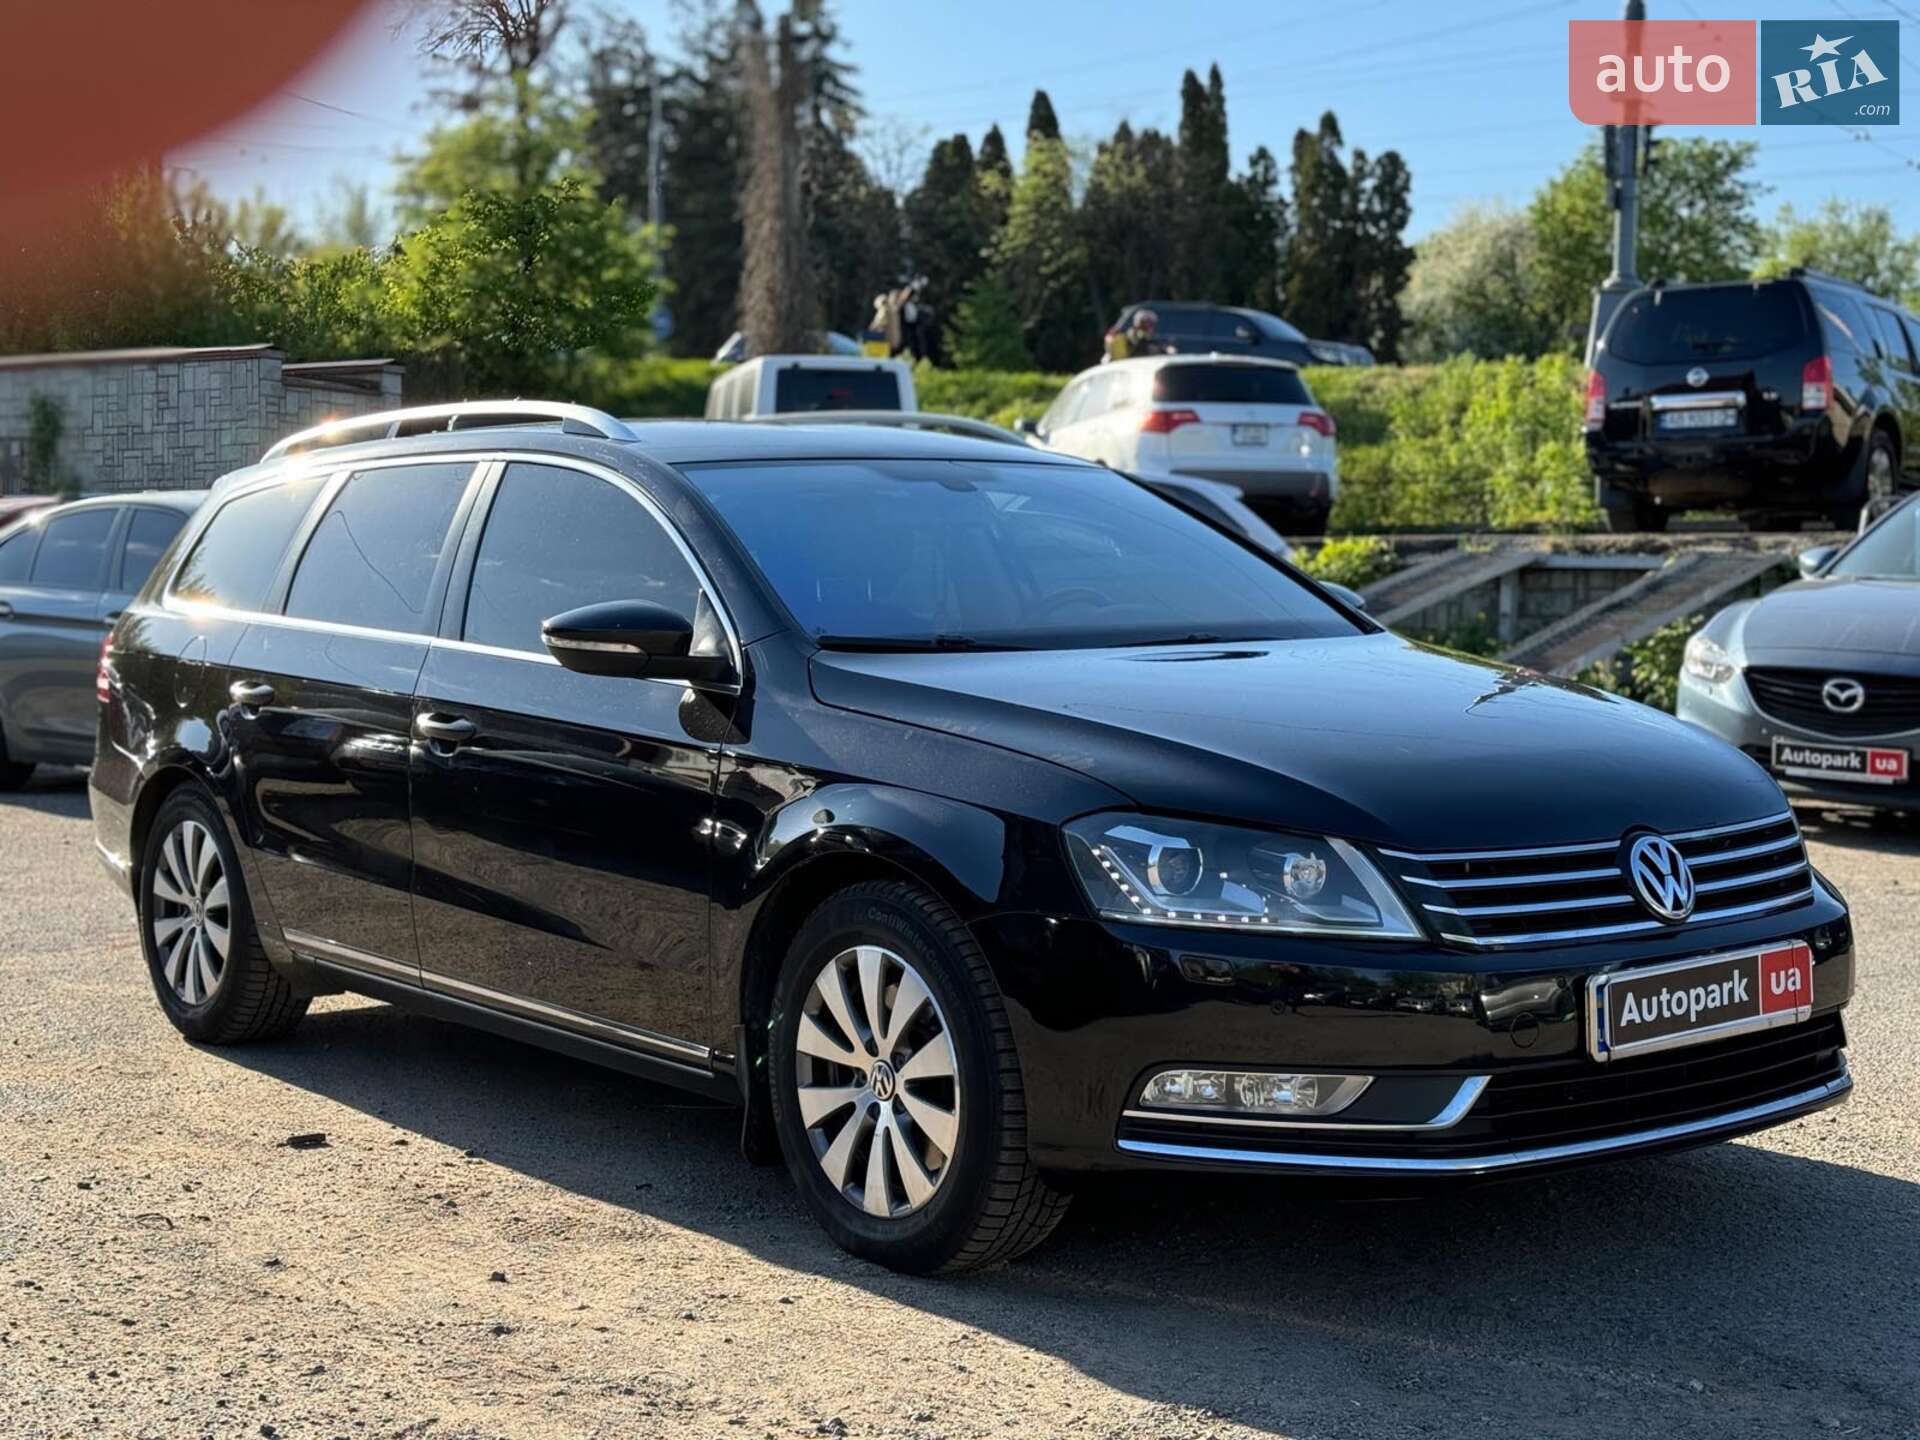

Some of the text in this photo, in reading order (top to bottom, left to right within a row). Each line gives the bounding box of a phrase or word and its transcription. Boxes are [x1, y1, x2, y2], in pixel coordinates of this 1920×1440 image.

[1780, 747, 1898, 772] Autopark ua
[1619, 967, 1802, 1027] Autopark ua
